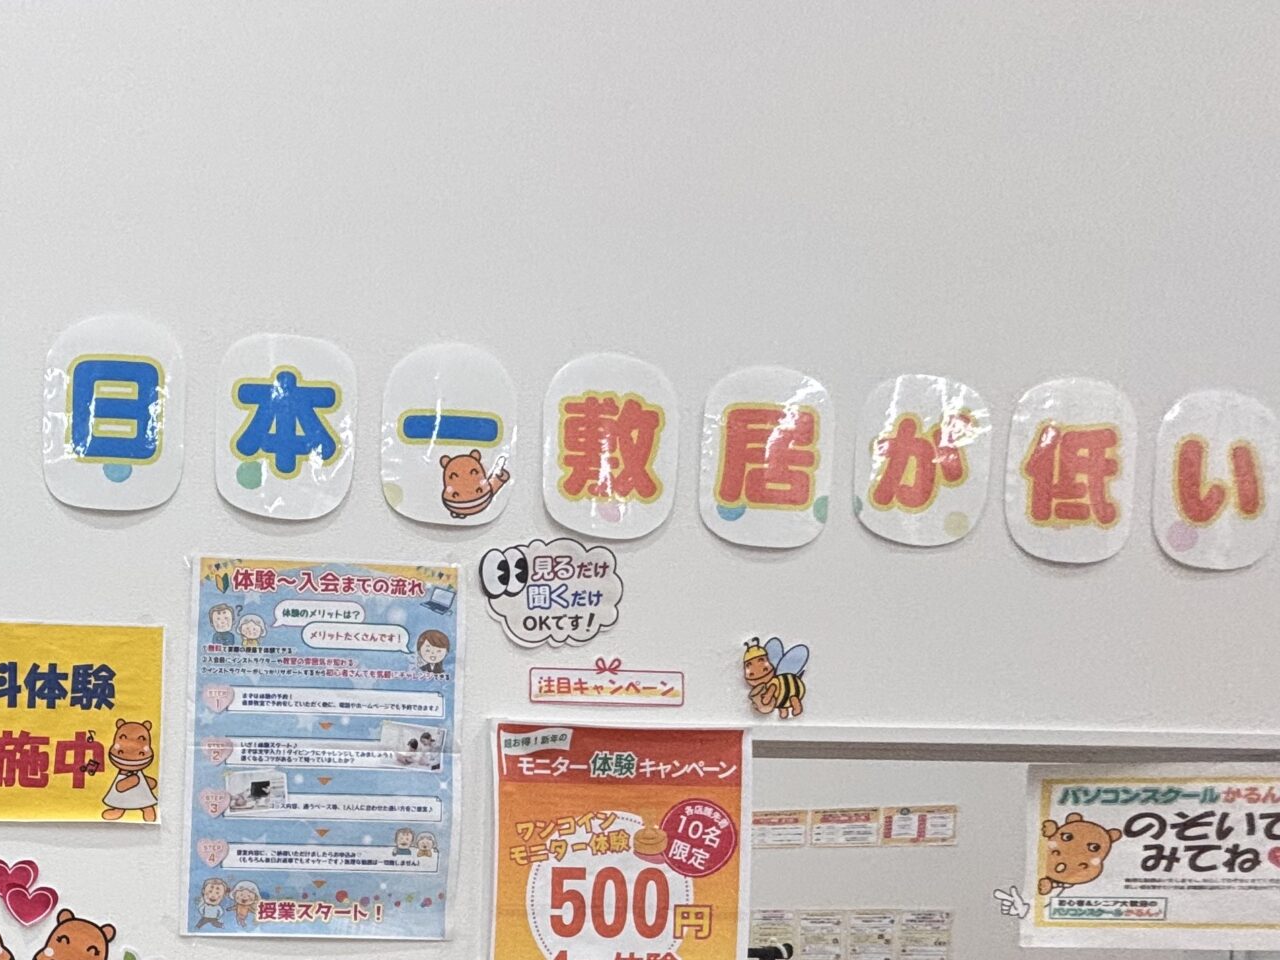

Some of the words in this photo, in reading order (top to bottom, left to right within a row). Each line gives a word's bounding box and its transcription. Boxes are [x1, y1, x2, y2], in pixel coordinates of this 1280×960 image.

[531, 556, 609, 581] 見るだけ
[526, 584, 603, 609] 聞くだけ
[282, 608, 361, 620] 体験のメリットは？
[523, 612, 596, 633] OKです！
[310, 631, 402, 644] メリットたくさんです！
[537, 675, 675, 697] 注目キャンペーン
[517, 751, 738, 779] モニター体験キャンペーン
[1057, 786, 1219, 806] パソコンスクール
[515, 811, 618, 842] ワンコイン
[676, 814, 722, 848] 10名
[510, 831, 631, 865] モニター体験
[668, 839, 710, 870] 限定
[1140, 843, 1262, 873] みてね
[257, 902, 384, 922] 授業スタート！
[549, 866, 713, 941] 500円
